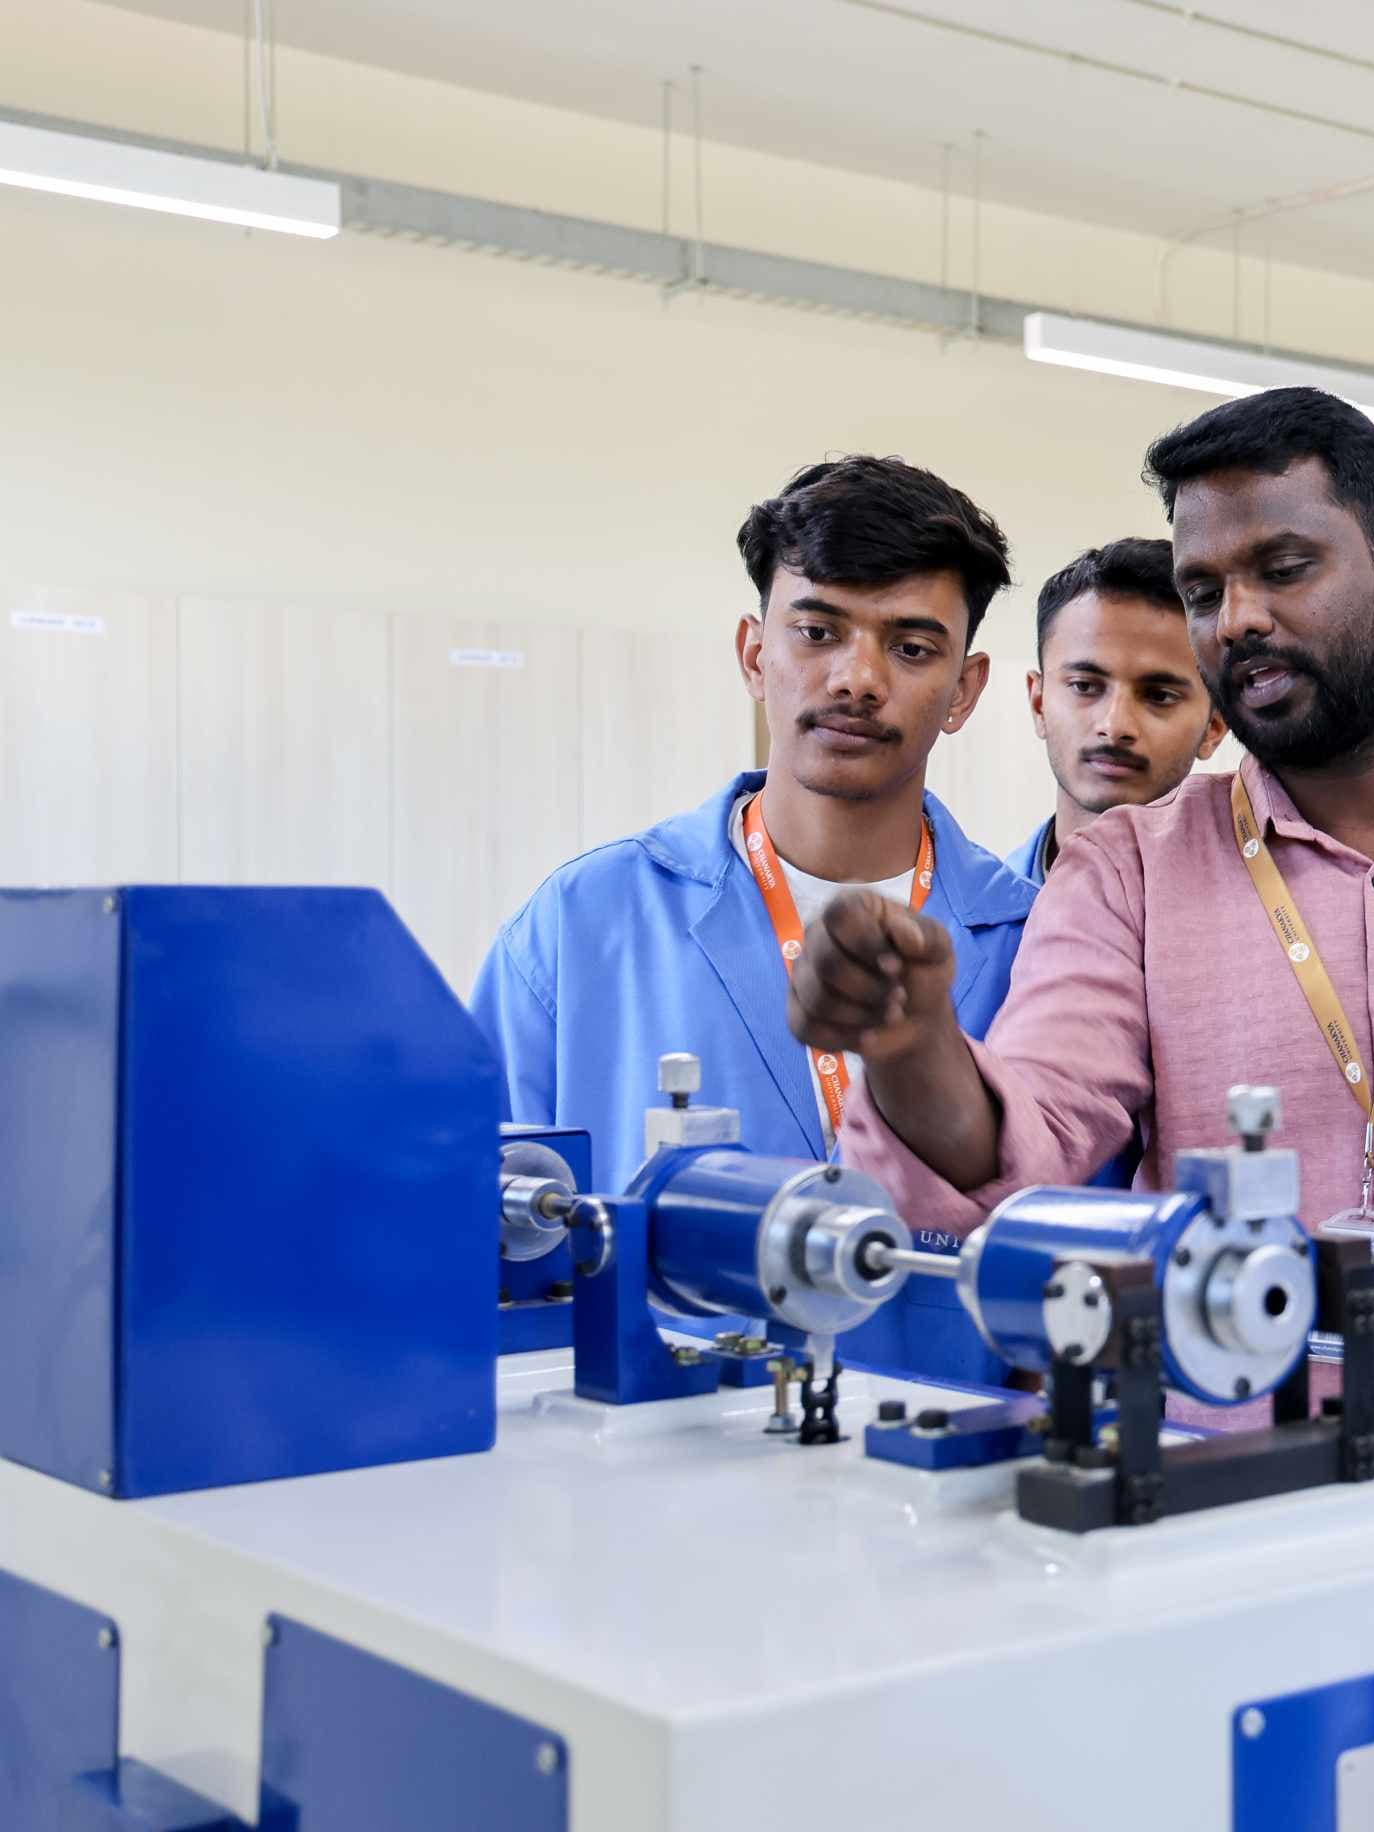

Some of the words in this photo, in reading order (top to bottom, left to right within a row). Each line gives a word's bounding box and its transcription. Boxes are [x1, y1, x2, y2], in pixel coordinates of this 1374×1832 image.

[758, 849, 776, 889] CHANAKYA
[1274, 907, 1294, 944] CHANAKYA
[1327, 1021, 1350, 1064] CHANAKYA
